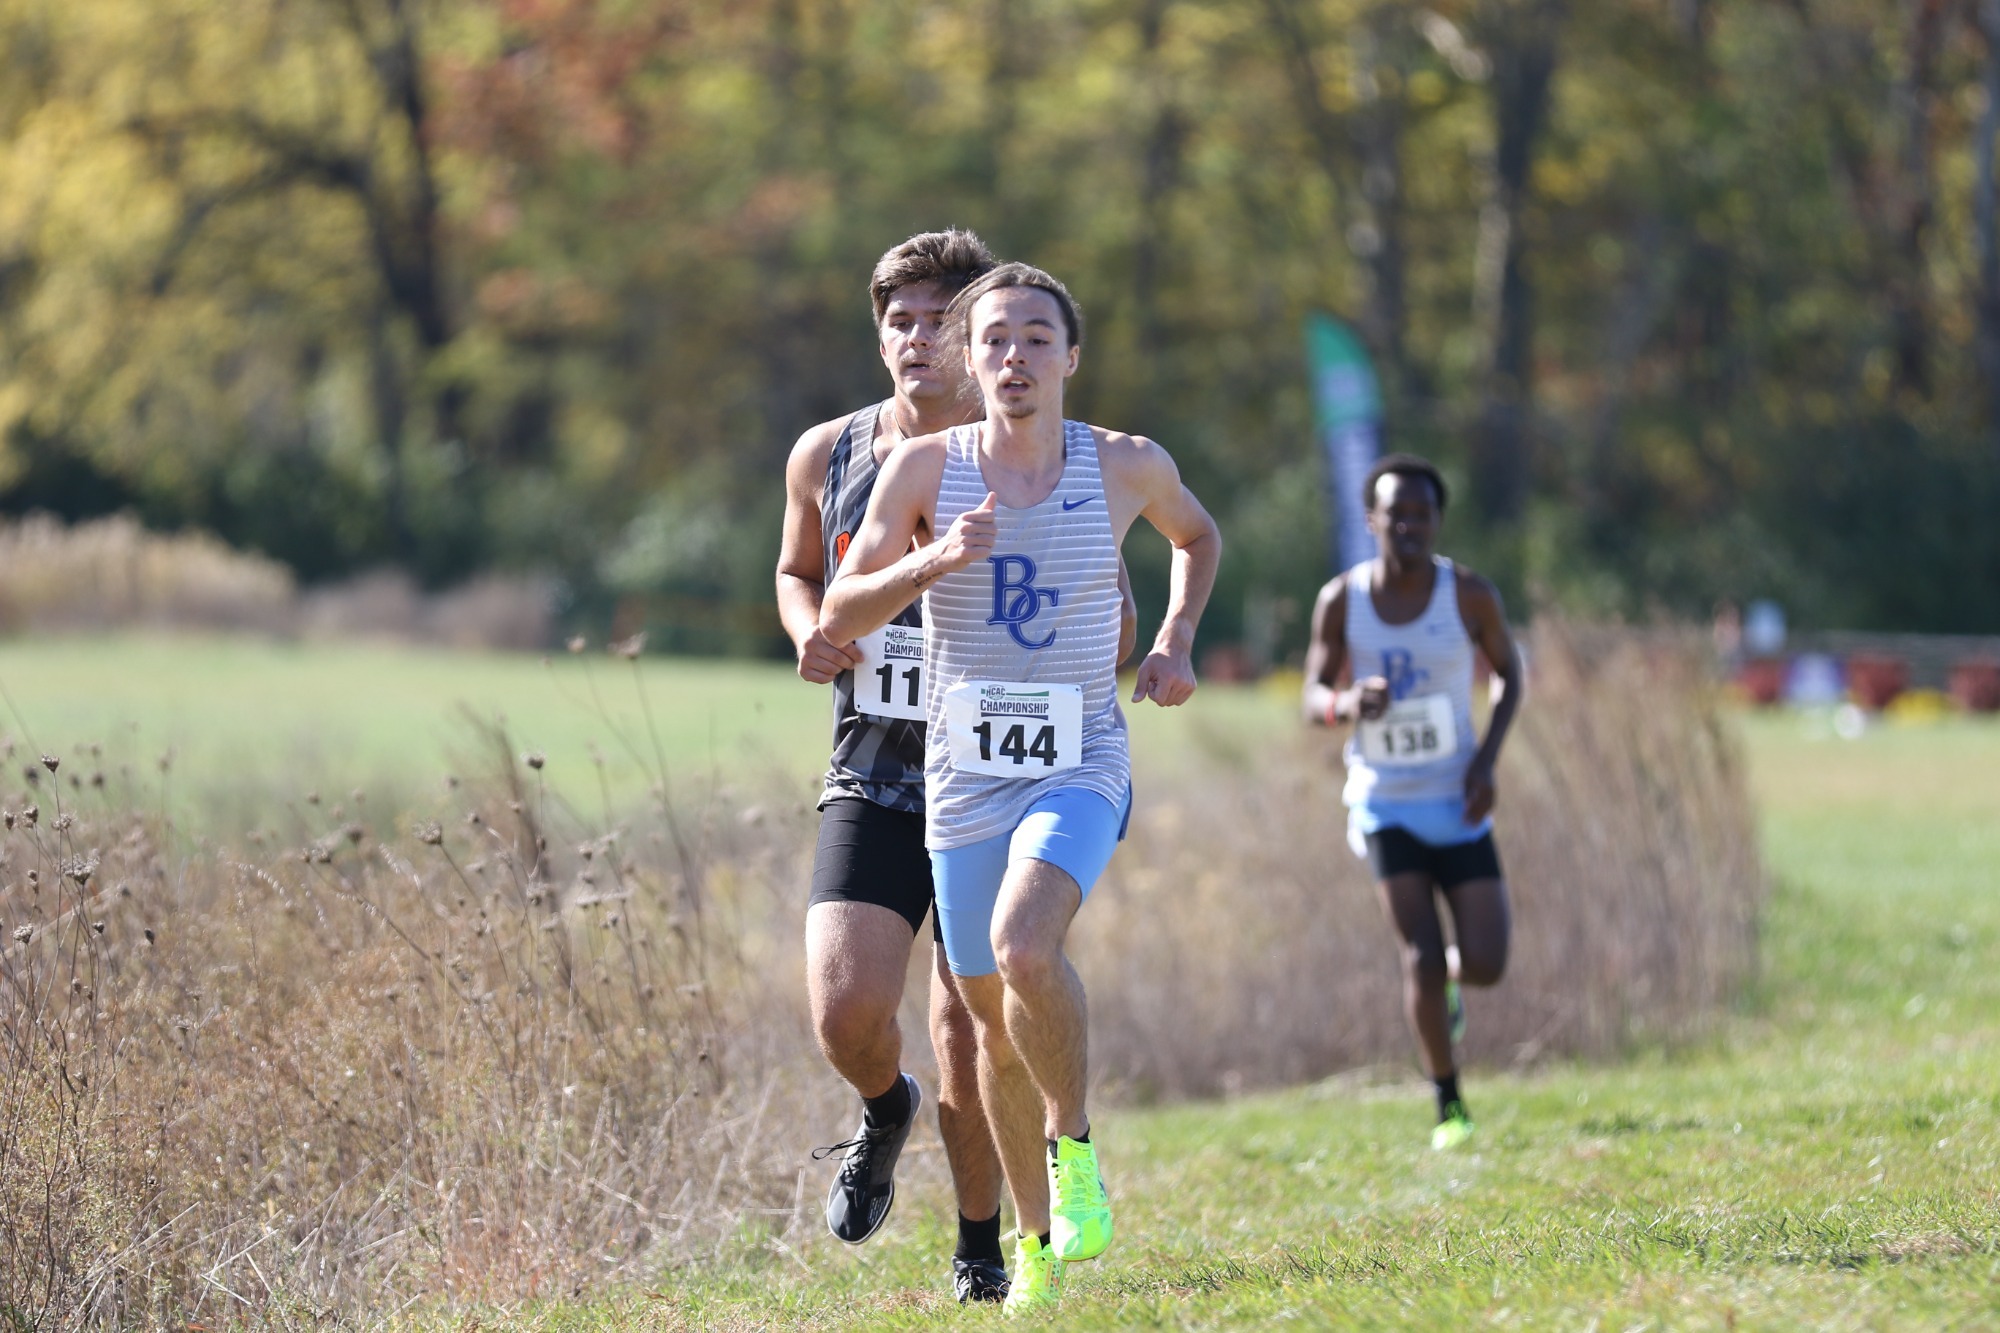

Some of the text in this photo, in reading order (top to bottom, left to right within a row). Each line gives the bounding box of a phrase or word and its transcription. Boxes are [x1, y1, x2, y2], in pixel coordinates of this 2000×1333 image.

[986, 553, 1059, 649] BC
[890, 631, 908, 640] HCAC
[884, 641, 924, 657] CHAMPIO
[986, 687, 1006, 697] HCAC
[980, 699, 1050, 714] CHAMPIONSHIP
[973, 721, 1058, 767] 144
